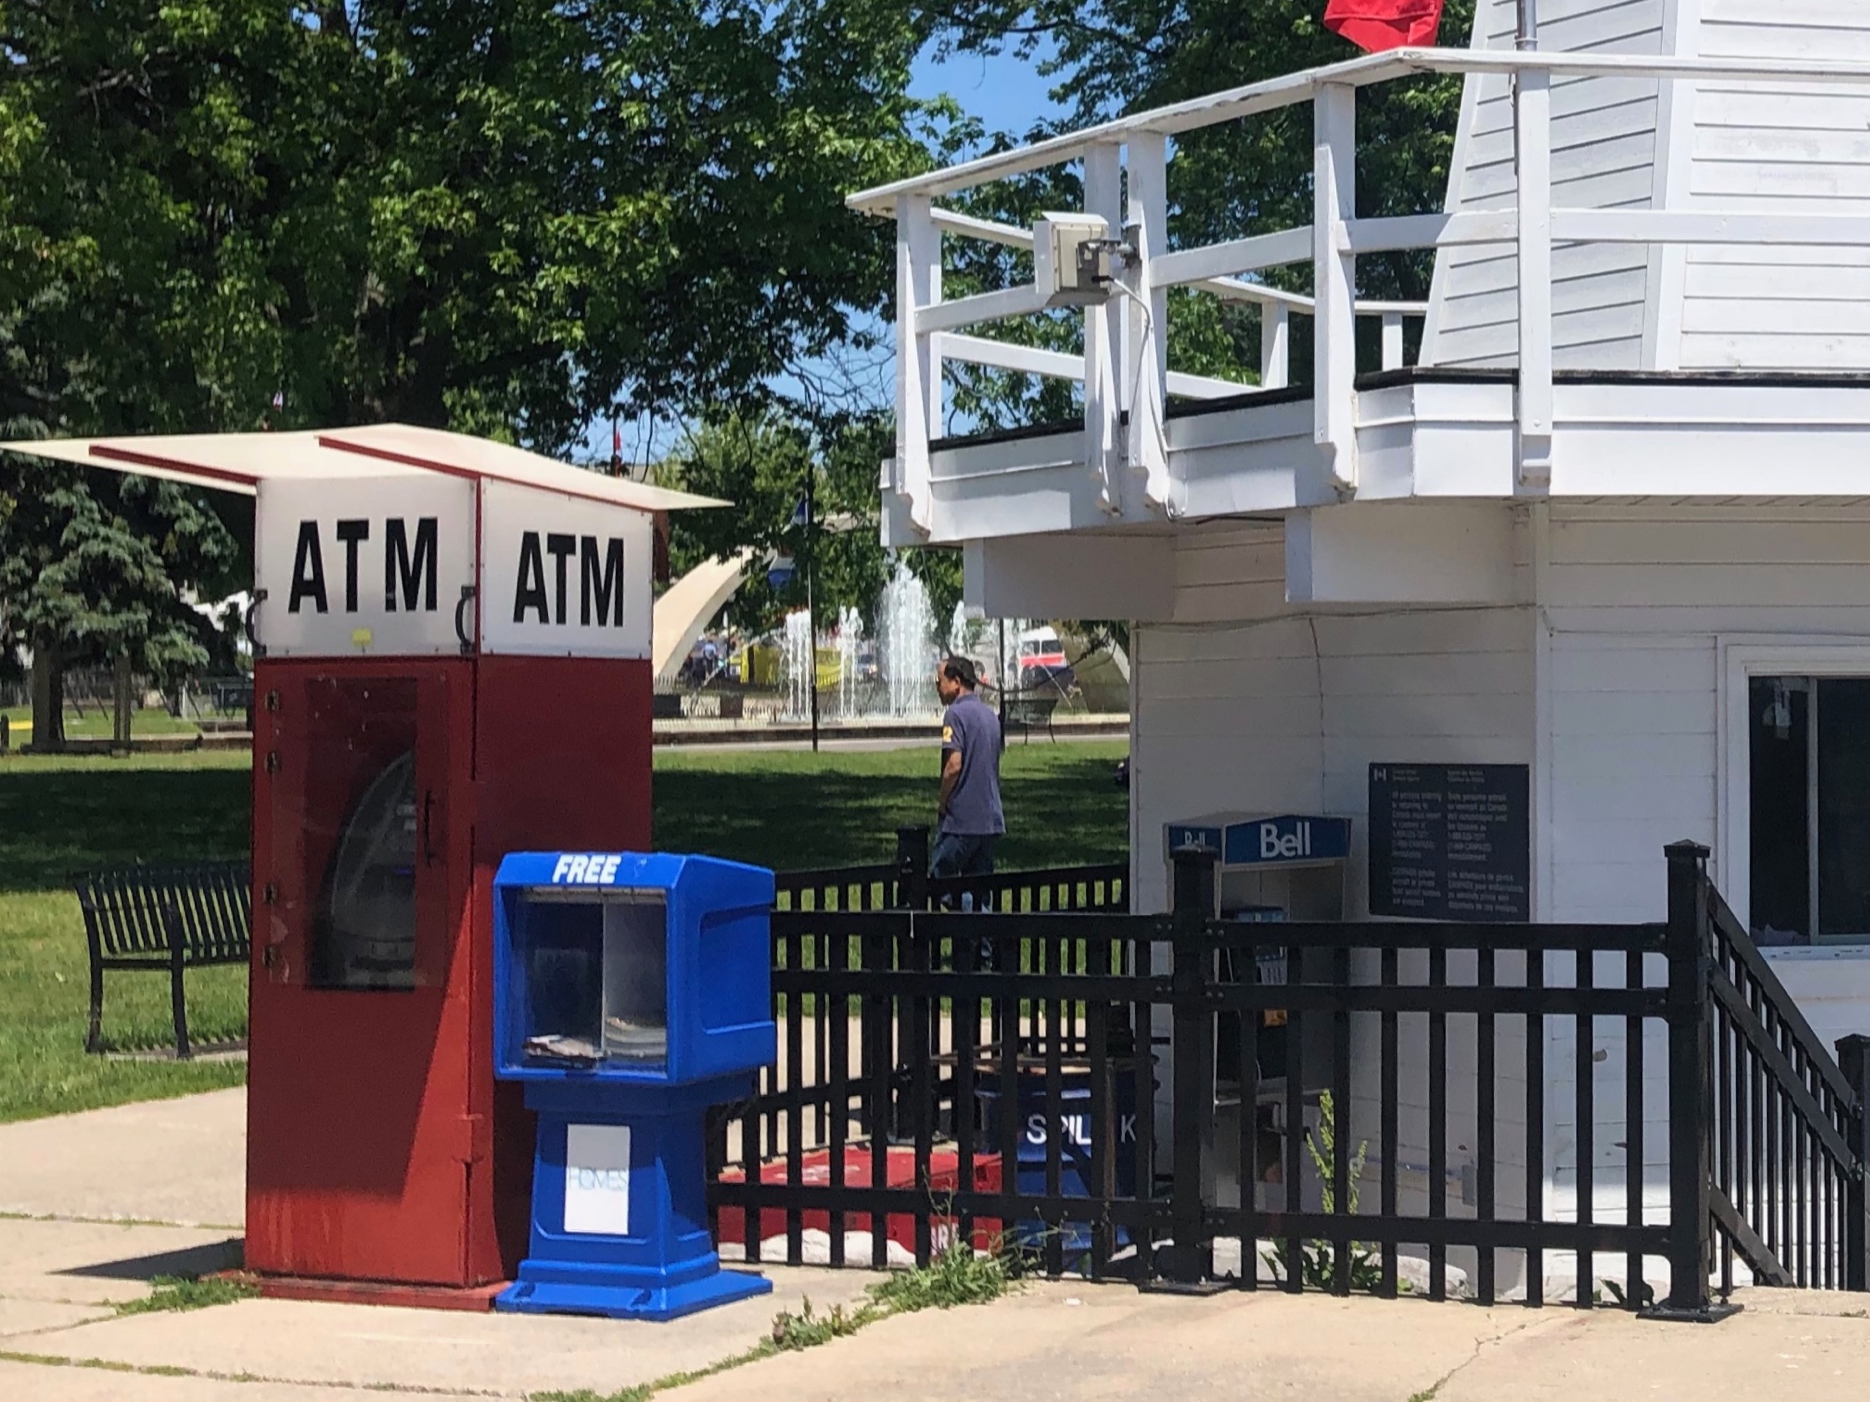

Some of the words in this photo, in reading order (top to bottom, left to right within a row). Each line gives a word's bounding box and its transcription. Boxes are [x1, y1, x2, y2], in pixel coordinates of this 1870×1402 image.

[288, 516, 438, 614] ATM
[513, 531, 625, 627] ATM
[551, 854, 621, 884] FREE
[1260, 821, 1311, 859] Bell
